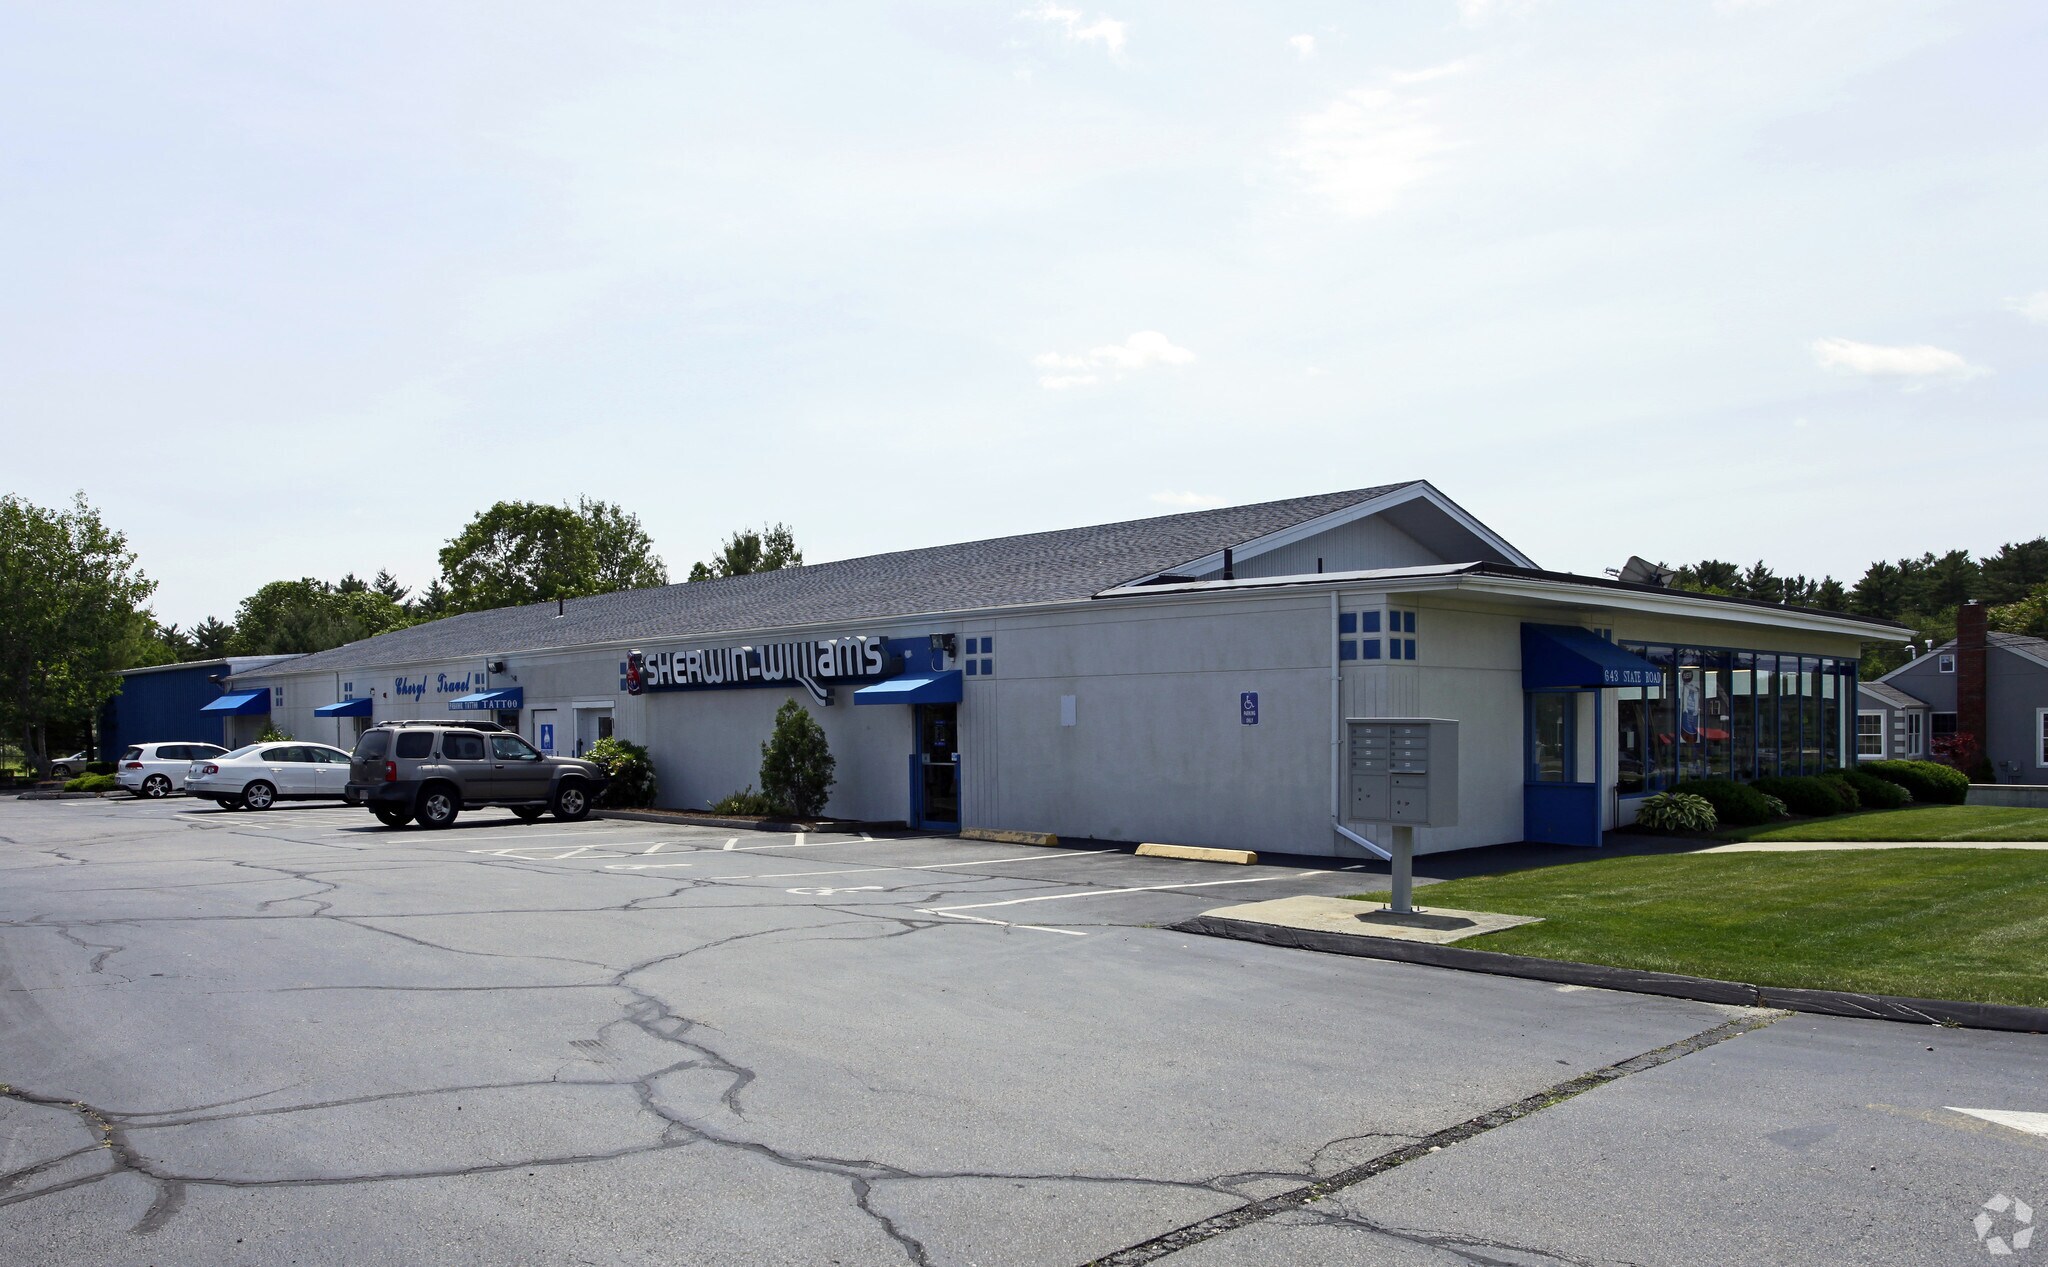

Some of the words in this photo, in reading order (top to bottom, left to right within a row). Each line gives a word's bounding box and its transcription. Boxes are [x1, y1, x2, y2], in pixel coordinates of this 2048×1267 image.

[1604, 670, 1619, 682] 643
[1623, 671, 1641, 683] STATE
[1645, 672, 1661, 684] ROAD
[395, 675, 427, 702] Cheryl
[437, 672, 471, 693] Travel
[482, 699, 518, 709] TATTOO
